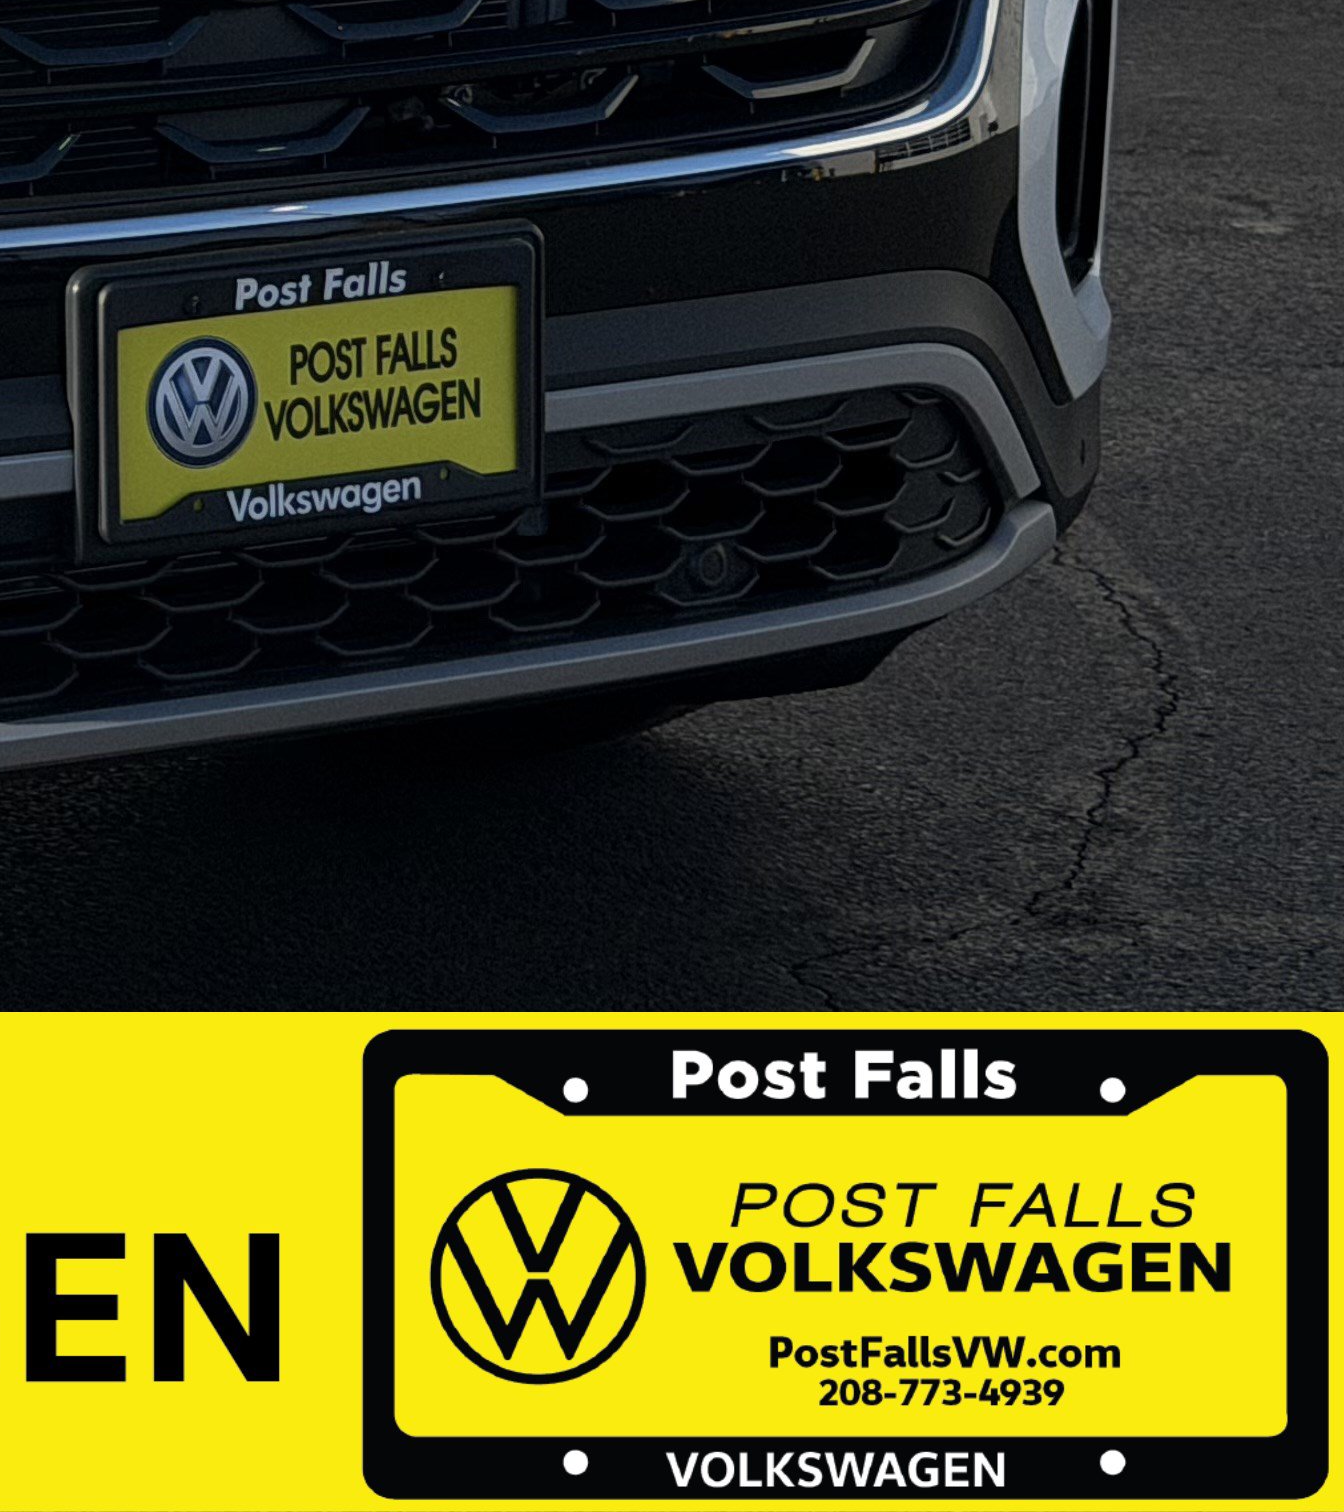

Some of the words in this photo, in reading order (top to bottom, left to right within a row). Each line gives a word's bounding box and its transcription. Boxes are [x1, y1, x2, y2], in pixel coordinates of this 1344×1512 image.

[234, 273, 311, 310] Post
[322, 260, 408, 301] Falls
[289, 337, 368, 386] POST
[375, 326, 458, 376] FALLS
[147, 336, 258, 468] VW
[263, 377, 482, 442] VOLKSWAGEN
[226, 474, 423, 523] Volkswagen
